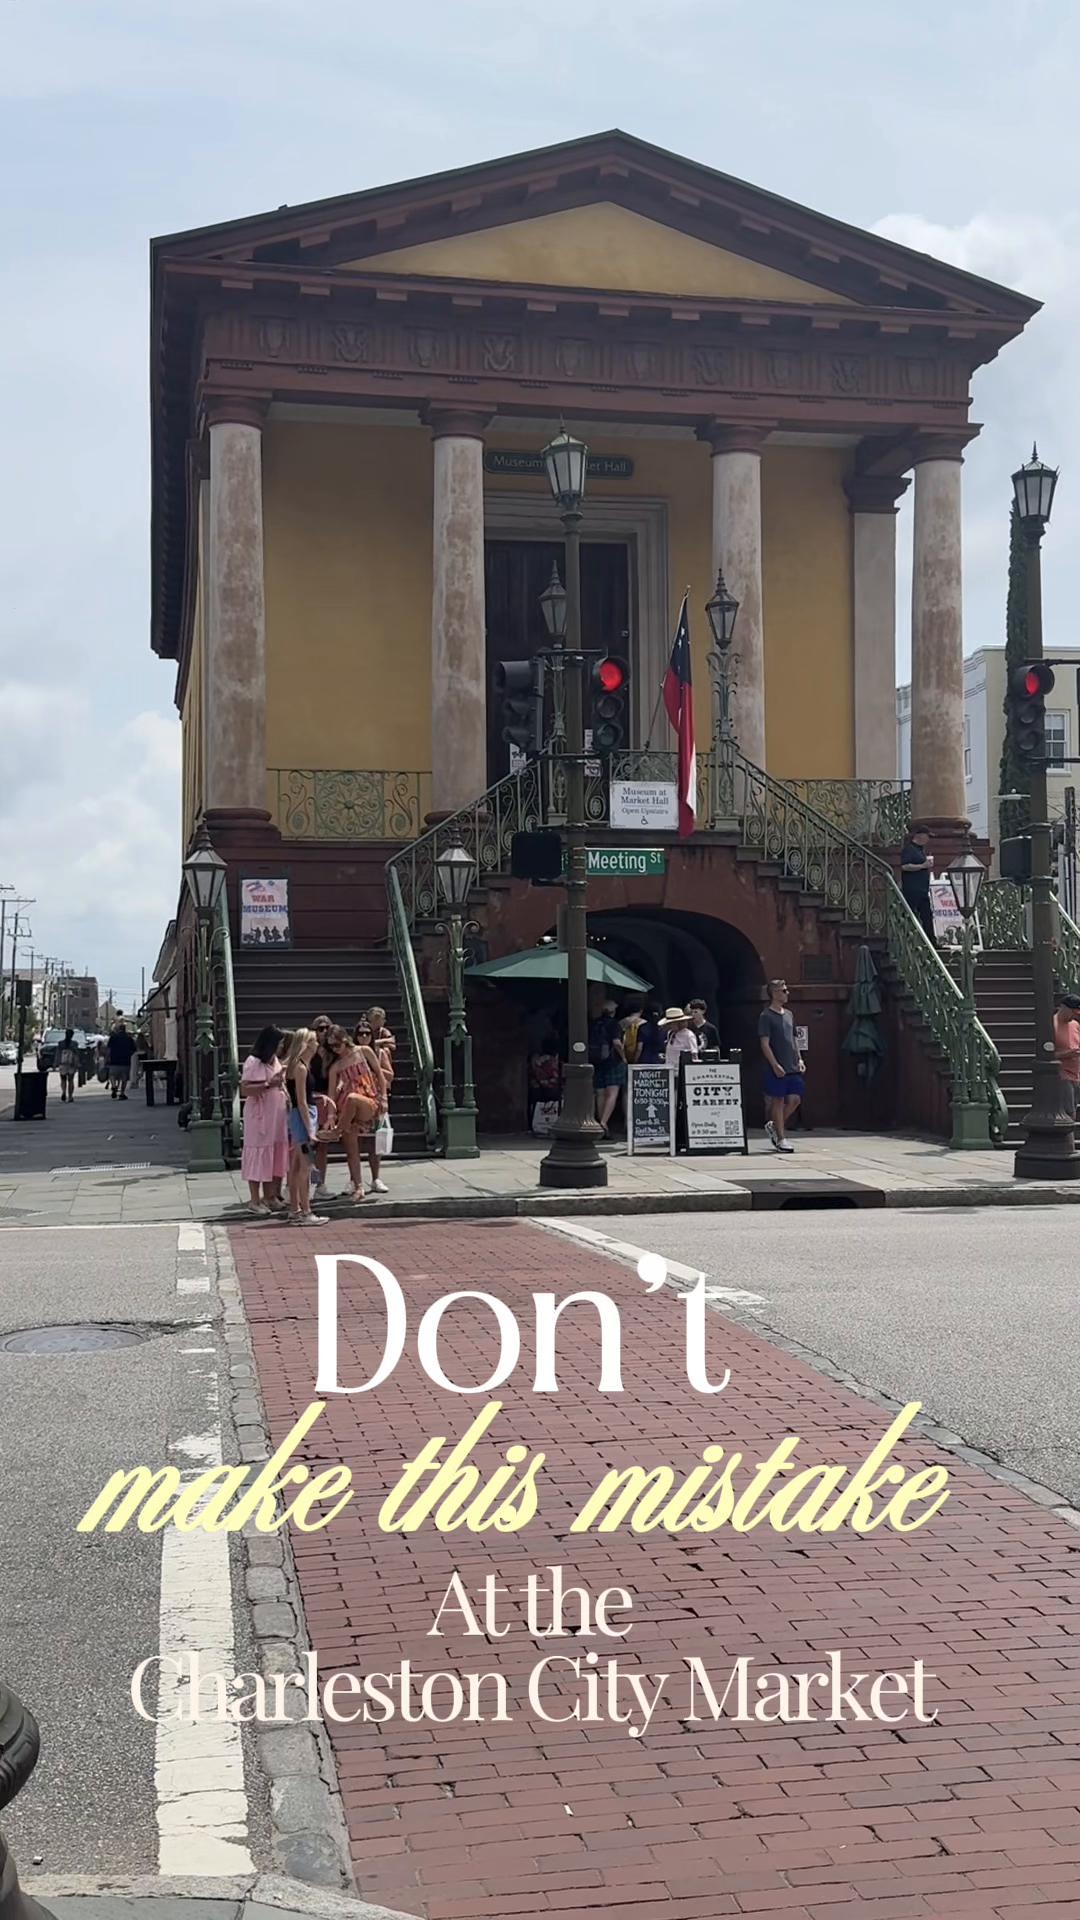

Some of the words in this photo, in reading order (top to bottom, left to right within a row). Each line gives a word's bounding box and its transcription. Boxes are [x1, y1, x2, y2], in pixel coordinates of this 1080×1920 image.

[494, 455, 543, 468] Museum
[604, 462, 626, 472] Hall
[622, 787, 657, 796] Museum
[659, 788, 667, 796] at
[621, 796, 650, 804] Market
[652, 797, 669, 805] Hall
[588, 851, 647, 873] Meeting
[650, 852, 661, 864] St
[251, 894, 275, 903] WAR
[242, 905, 289, 913] MUSEUM
[639, 1071, 661, 1079] NIGHT
[634, 1080, 667, 1088] MARKET
[634, 1088, 669, 1098] TONIGHT
[693, 1086, 733, 1096] CITY
